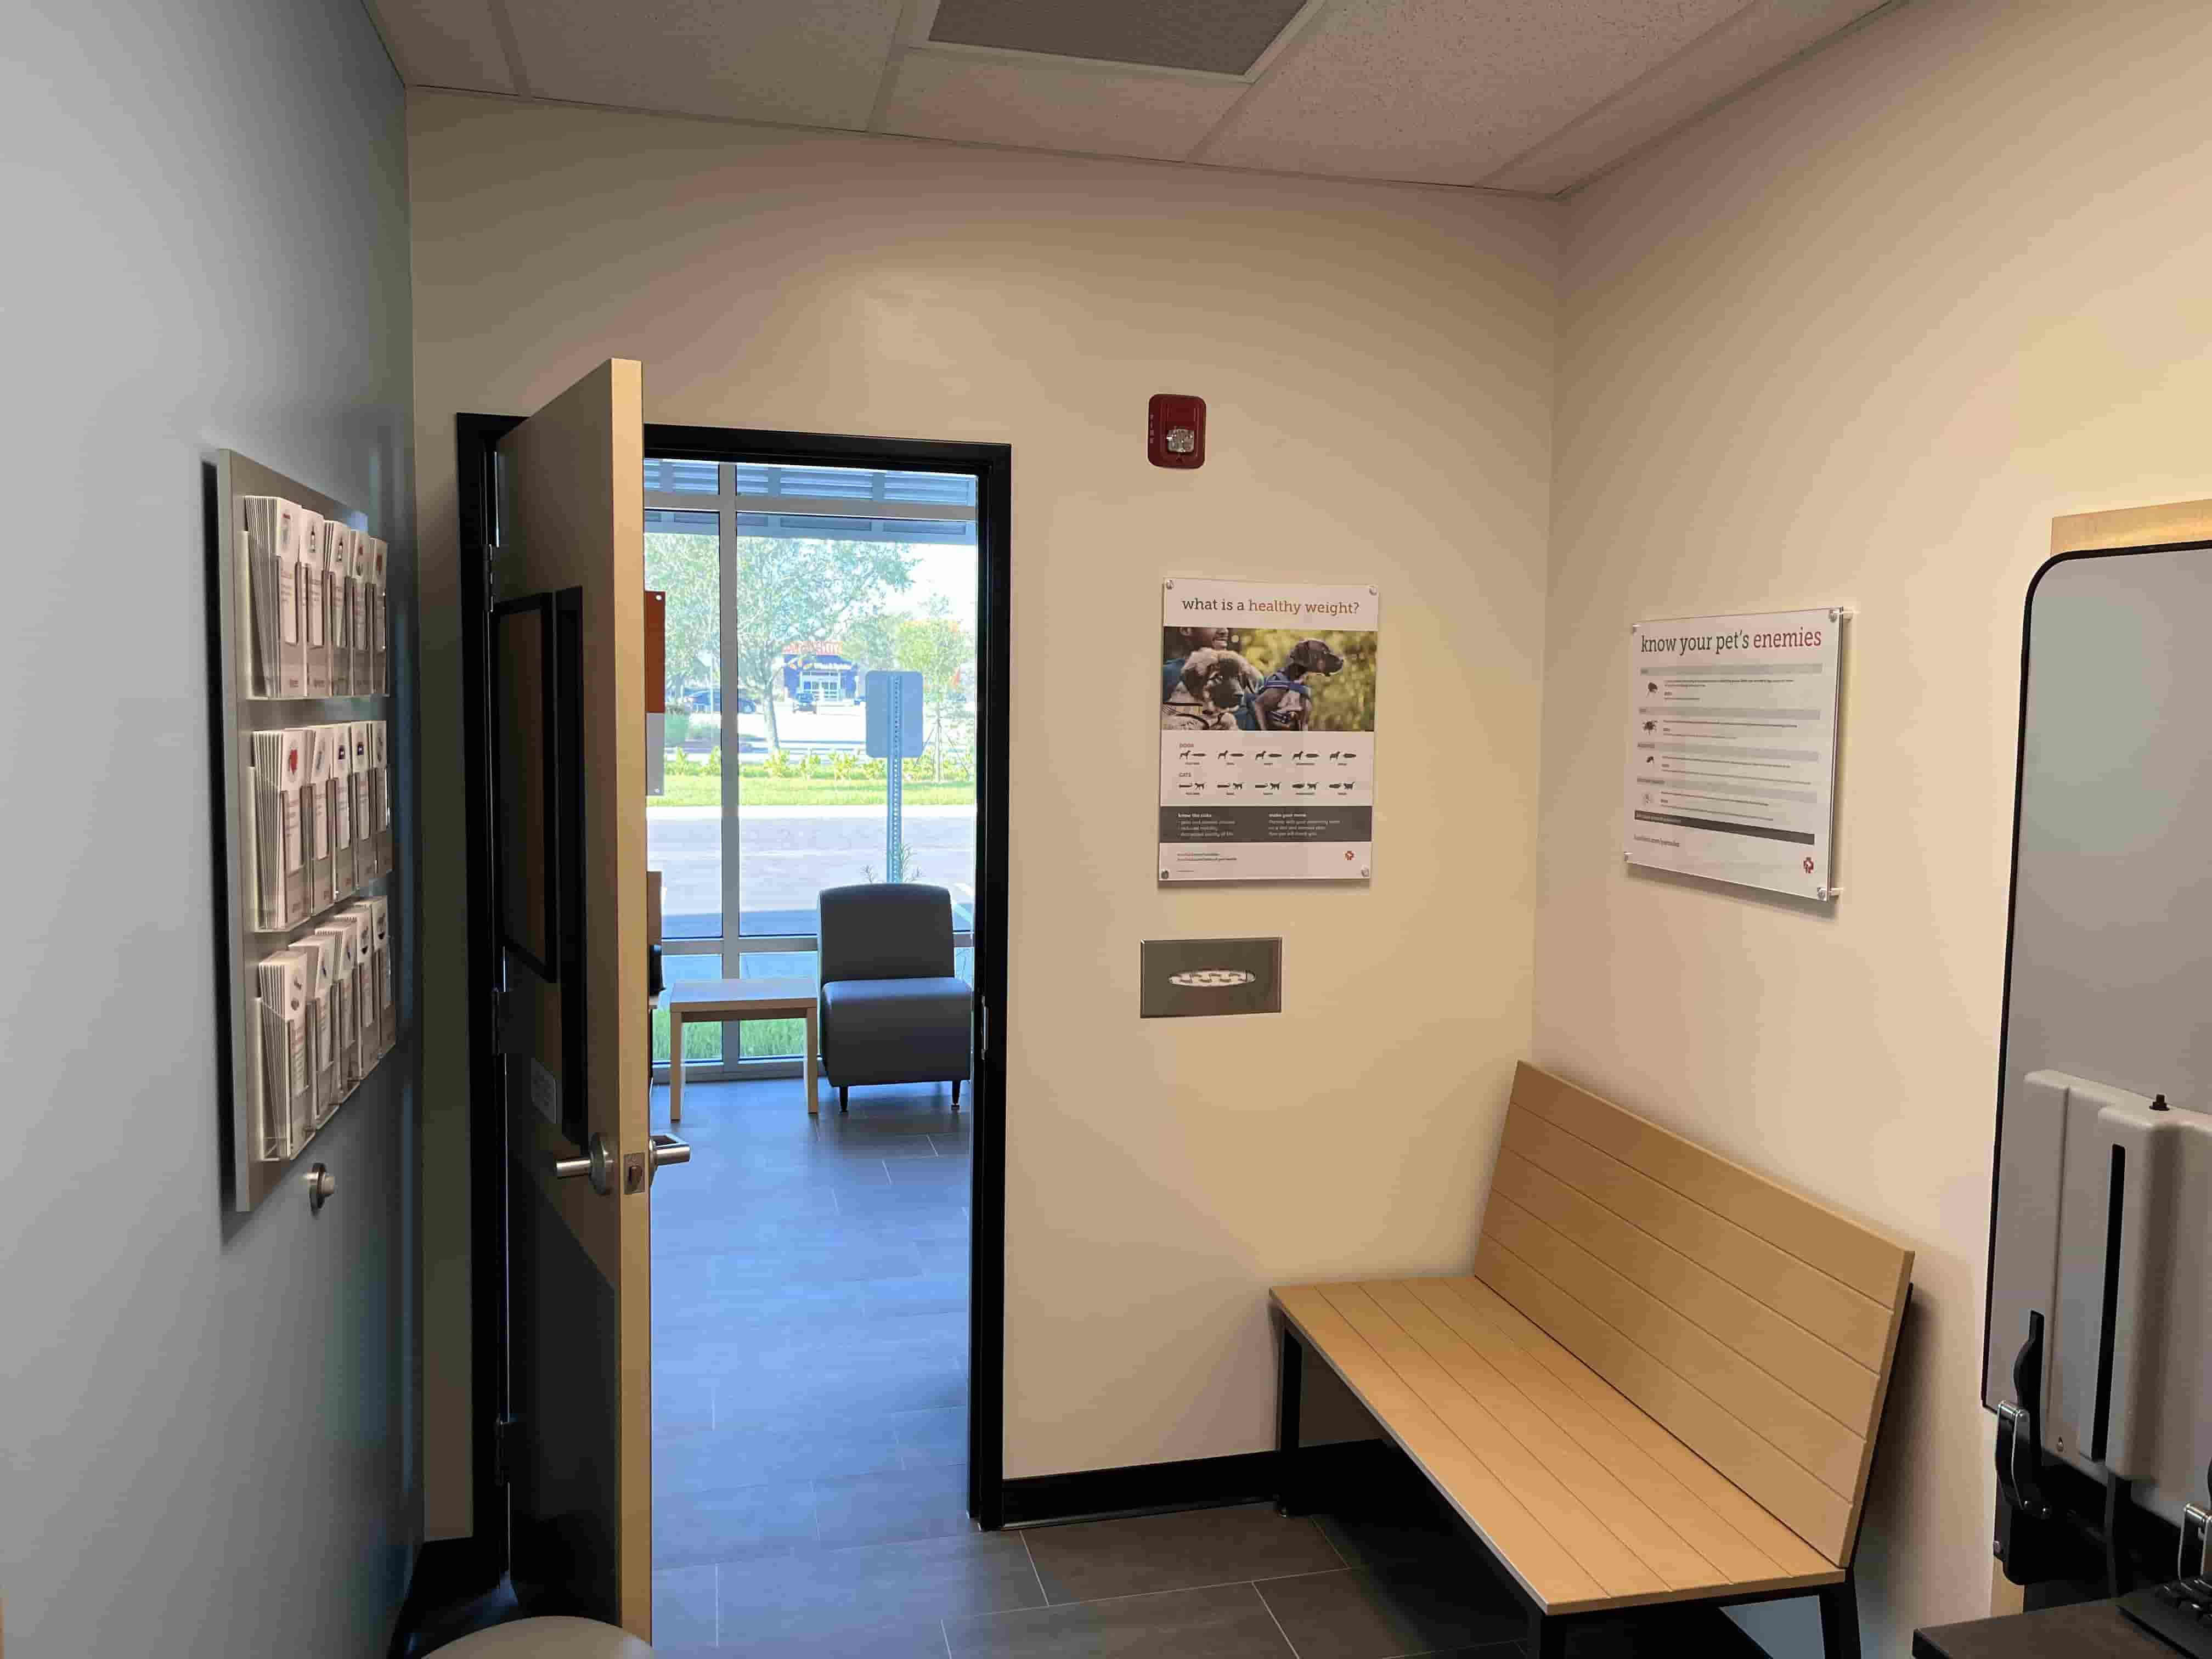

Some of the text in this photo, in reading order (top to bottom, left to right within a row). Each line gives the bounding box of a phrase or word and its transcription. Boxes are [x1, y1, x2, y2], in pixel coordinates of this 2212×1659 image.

[1182, 597, 1359, 616] what is a healthy weight?
[1641, 635, 1677, 652] know
[1679, 636, 1712, 656] your
[1753, 627, 1822, 648] enemies
